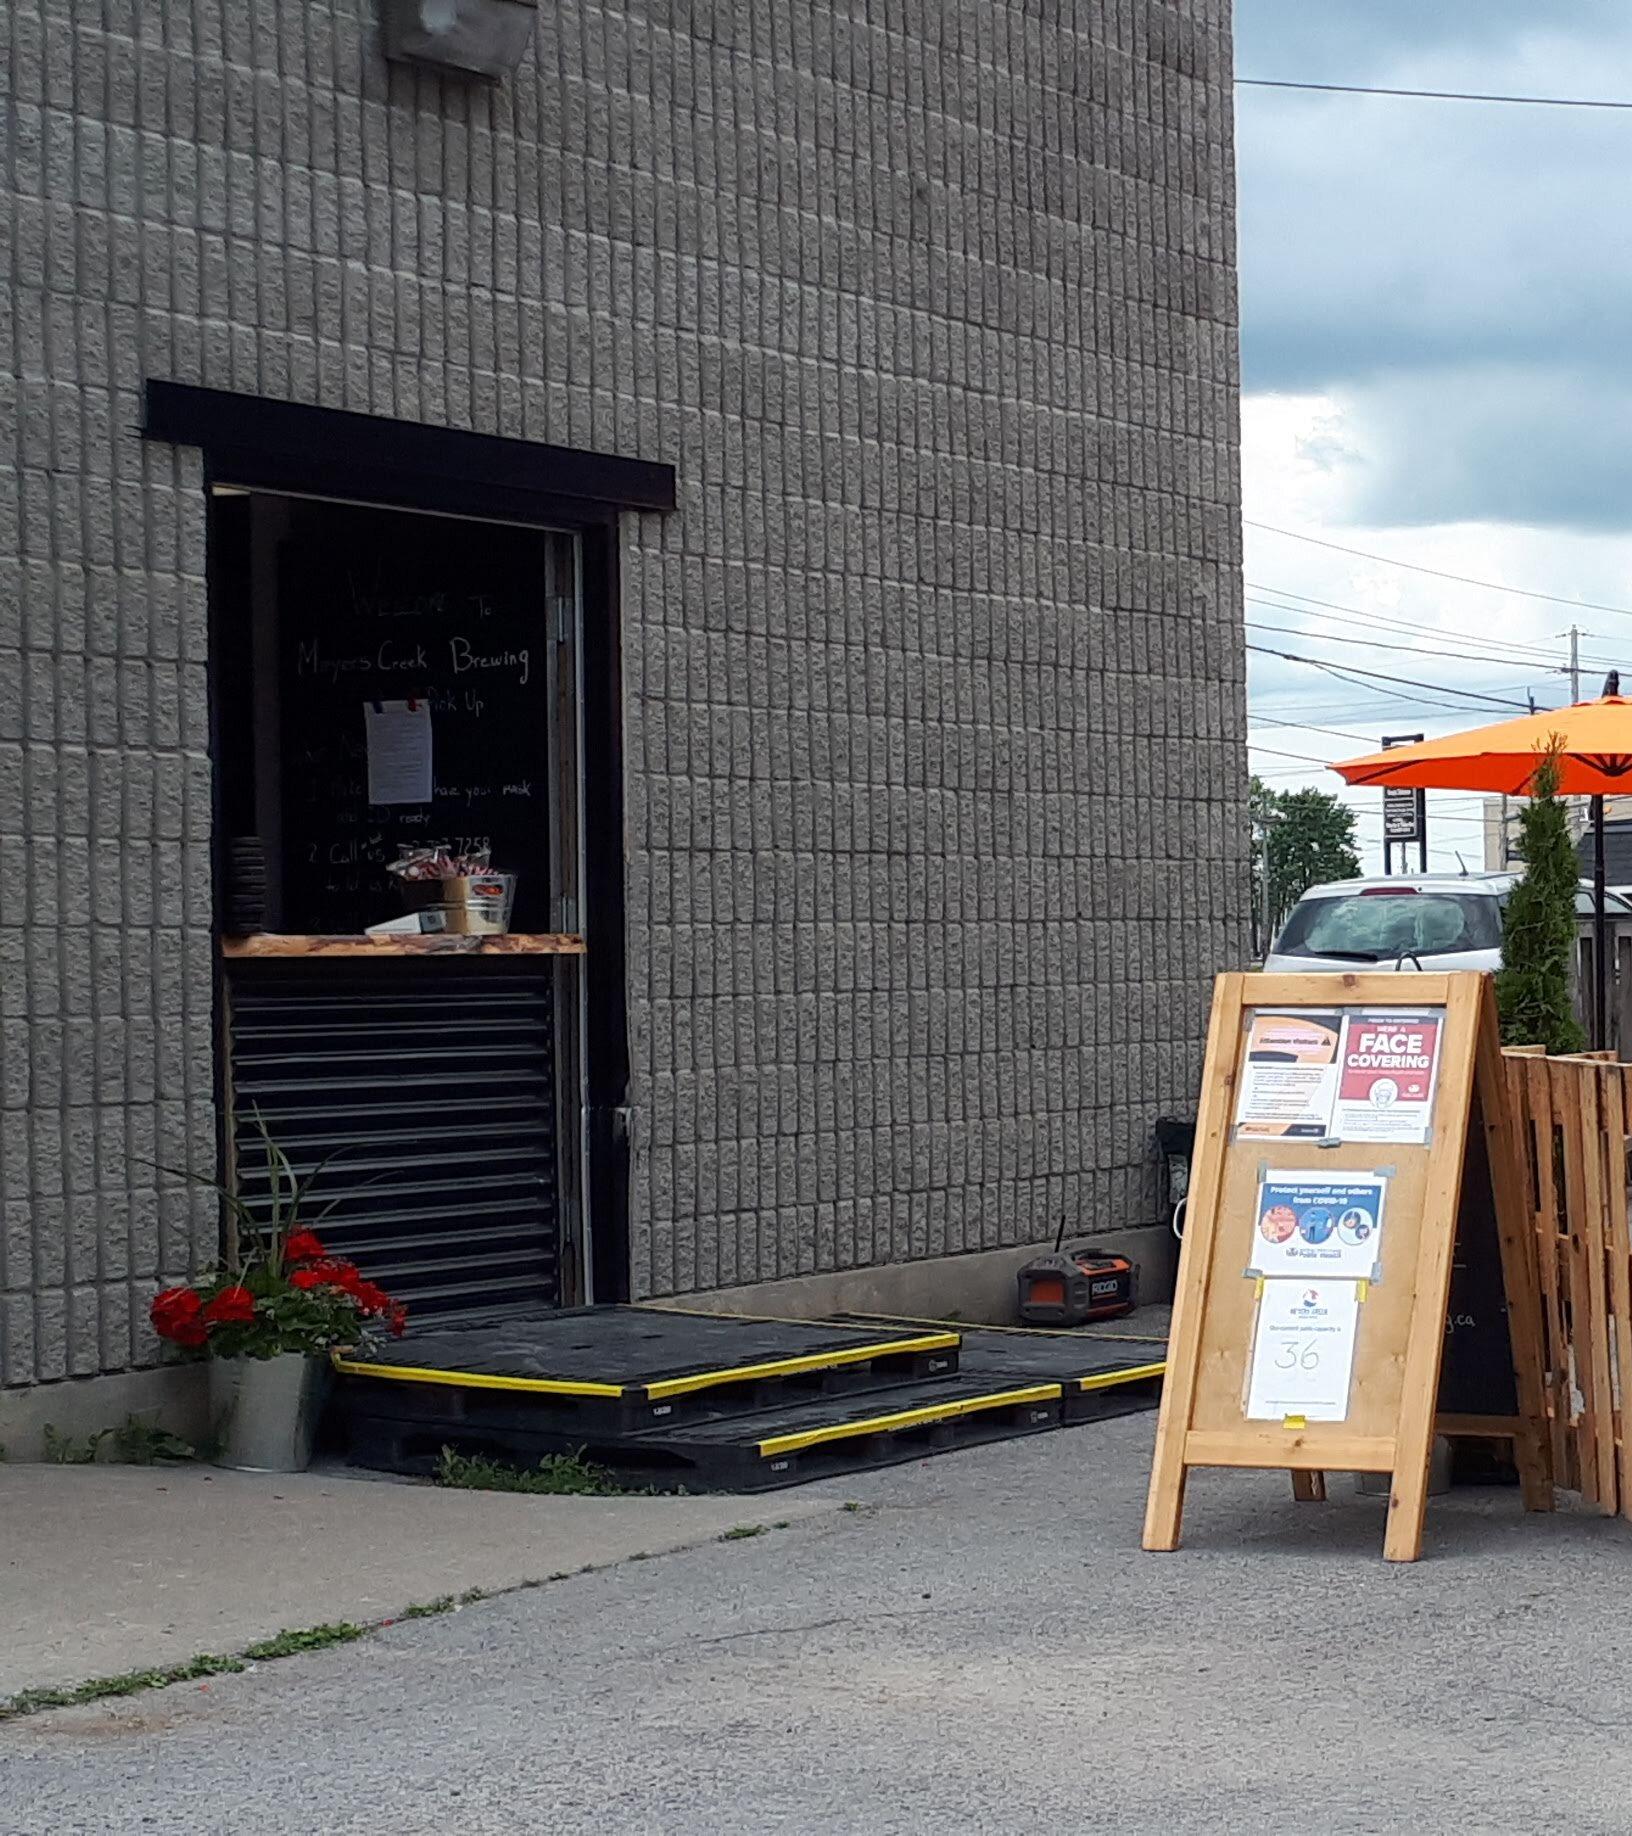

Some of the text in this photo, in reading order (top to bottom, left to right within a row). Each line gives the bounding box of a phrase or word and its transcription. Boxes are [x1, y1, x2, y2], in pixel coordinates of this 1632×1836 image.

[377, 640, 427, 671] Creek
[449, 636, 529, 685] Brewing
[464, 688, 485, 717] Up
[1358, 1033, 1424, 1054] FACE
[1347, 1053, 1430, 1069] COVERING
[1270, 1186, 1373, 1196] Protect yourself and others
[1293, 1196, 1312, 1204] from
[1274, 1338, 1320, 1370] 36
